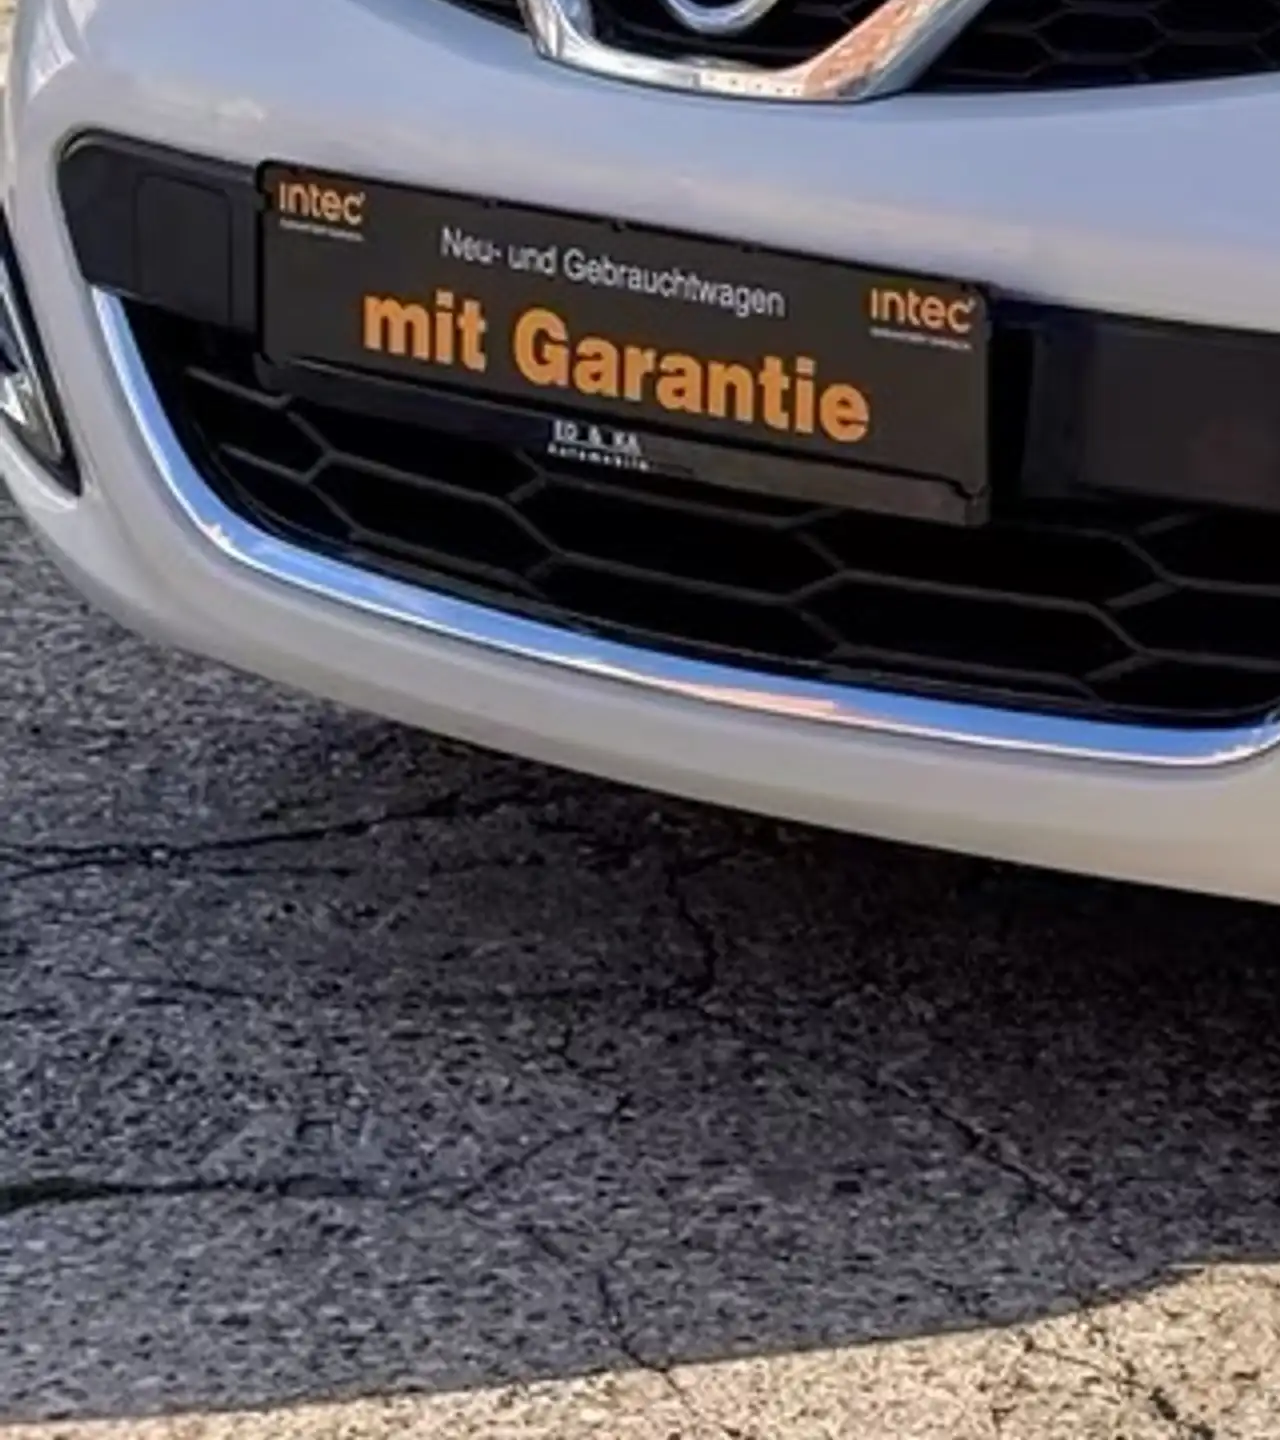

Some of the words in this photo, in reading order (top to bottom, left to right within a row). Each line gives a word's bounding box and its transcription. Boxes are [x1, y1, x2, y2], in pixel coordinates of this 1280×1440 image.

[440, 226, 501, 263] Neu-
[507, 244, 557, 275] und
[563, 248, 786, 318] Gebrauchtwagen
[363, 289, 487, 372] mit
[513, 307, 871, 443] Garantie
